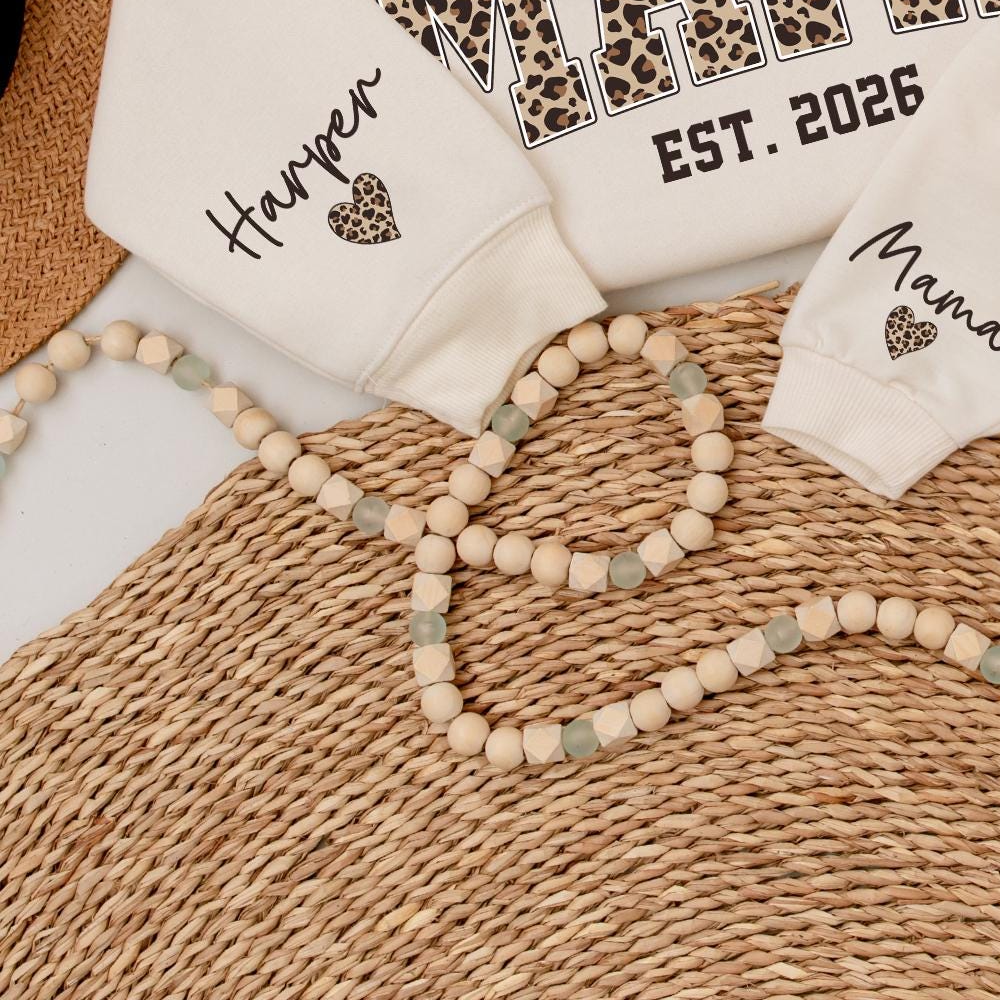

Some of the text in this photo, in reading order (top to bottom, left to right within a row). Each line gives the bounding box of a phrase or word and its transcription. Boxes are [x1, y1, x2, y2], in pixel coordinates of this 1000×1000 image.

[206, 67, 382, 260] Harper
[652, 63, 925, 184] EST. 2026
